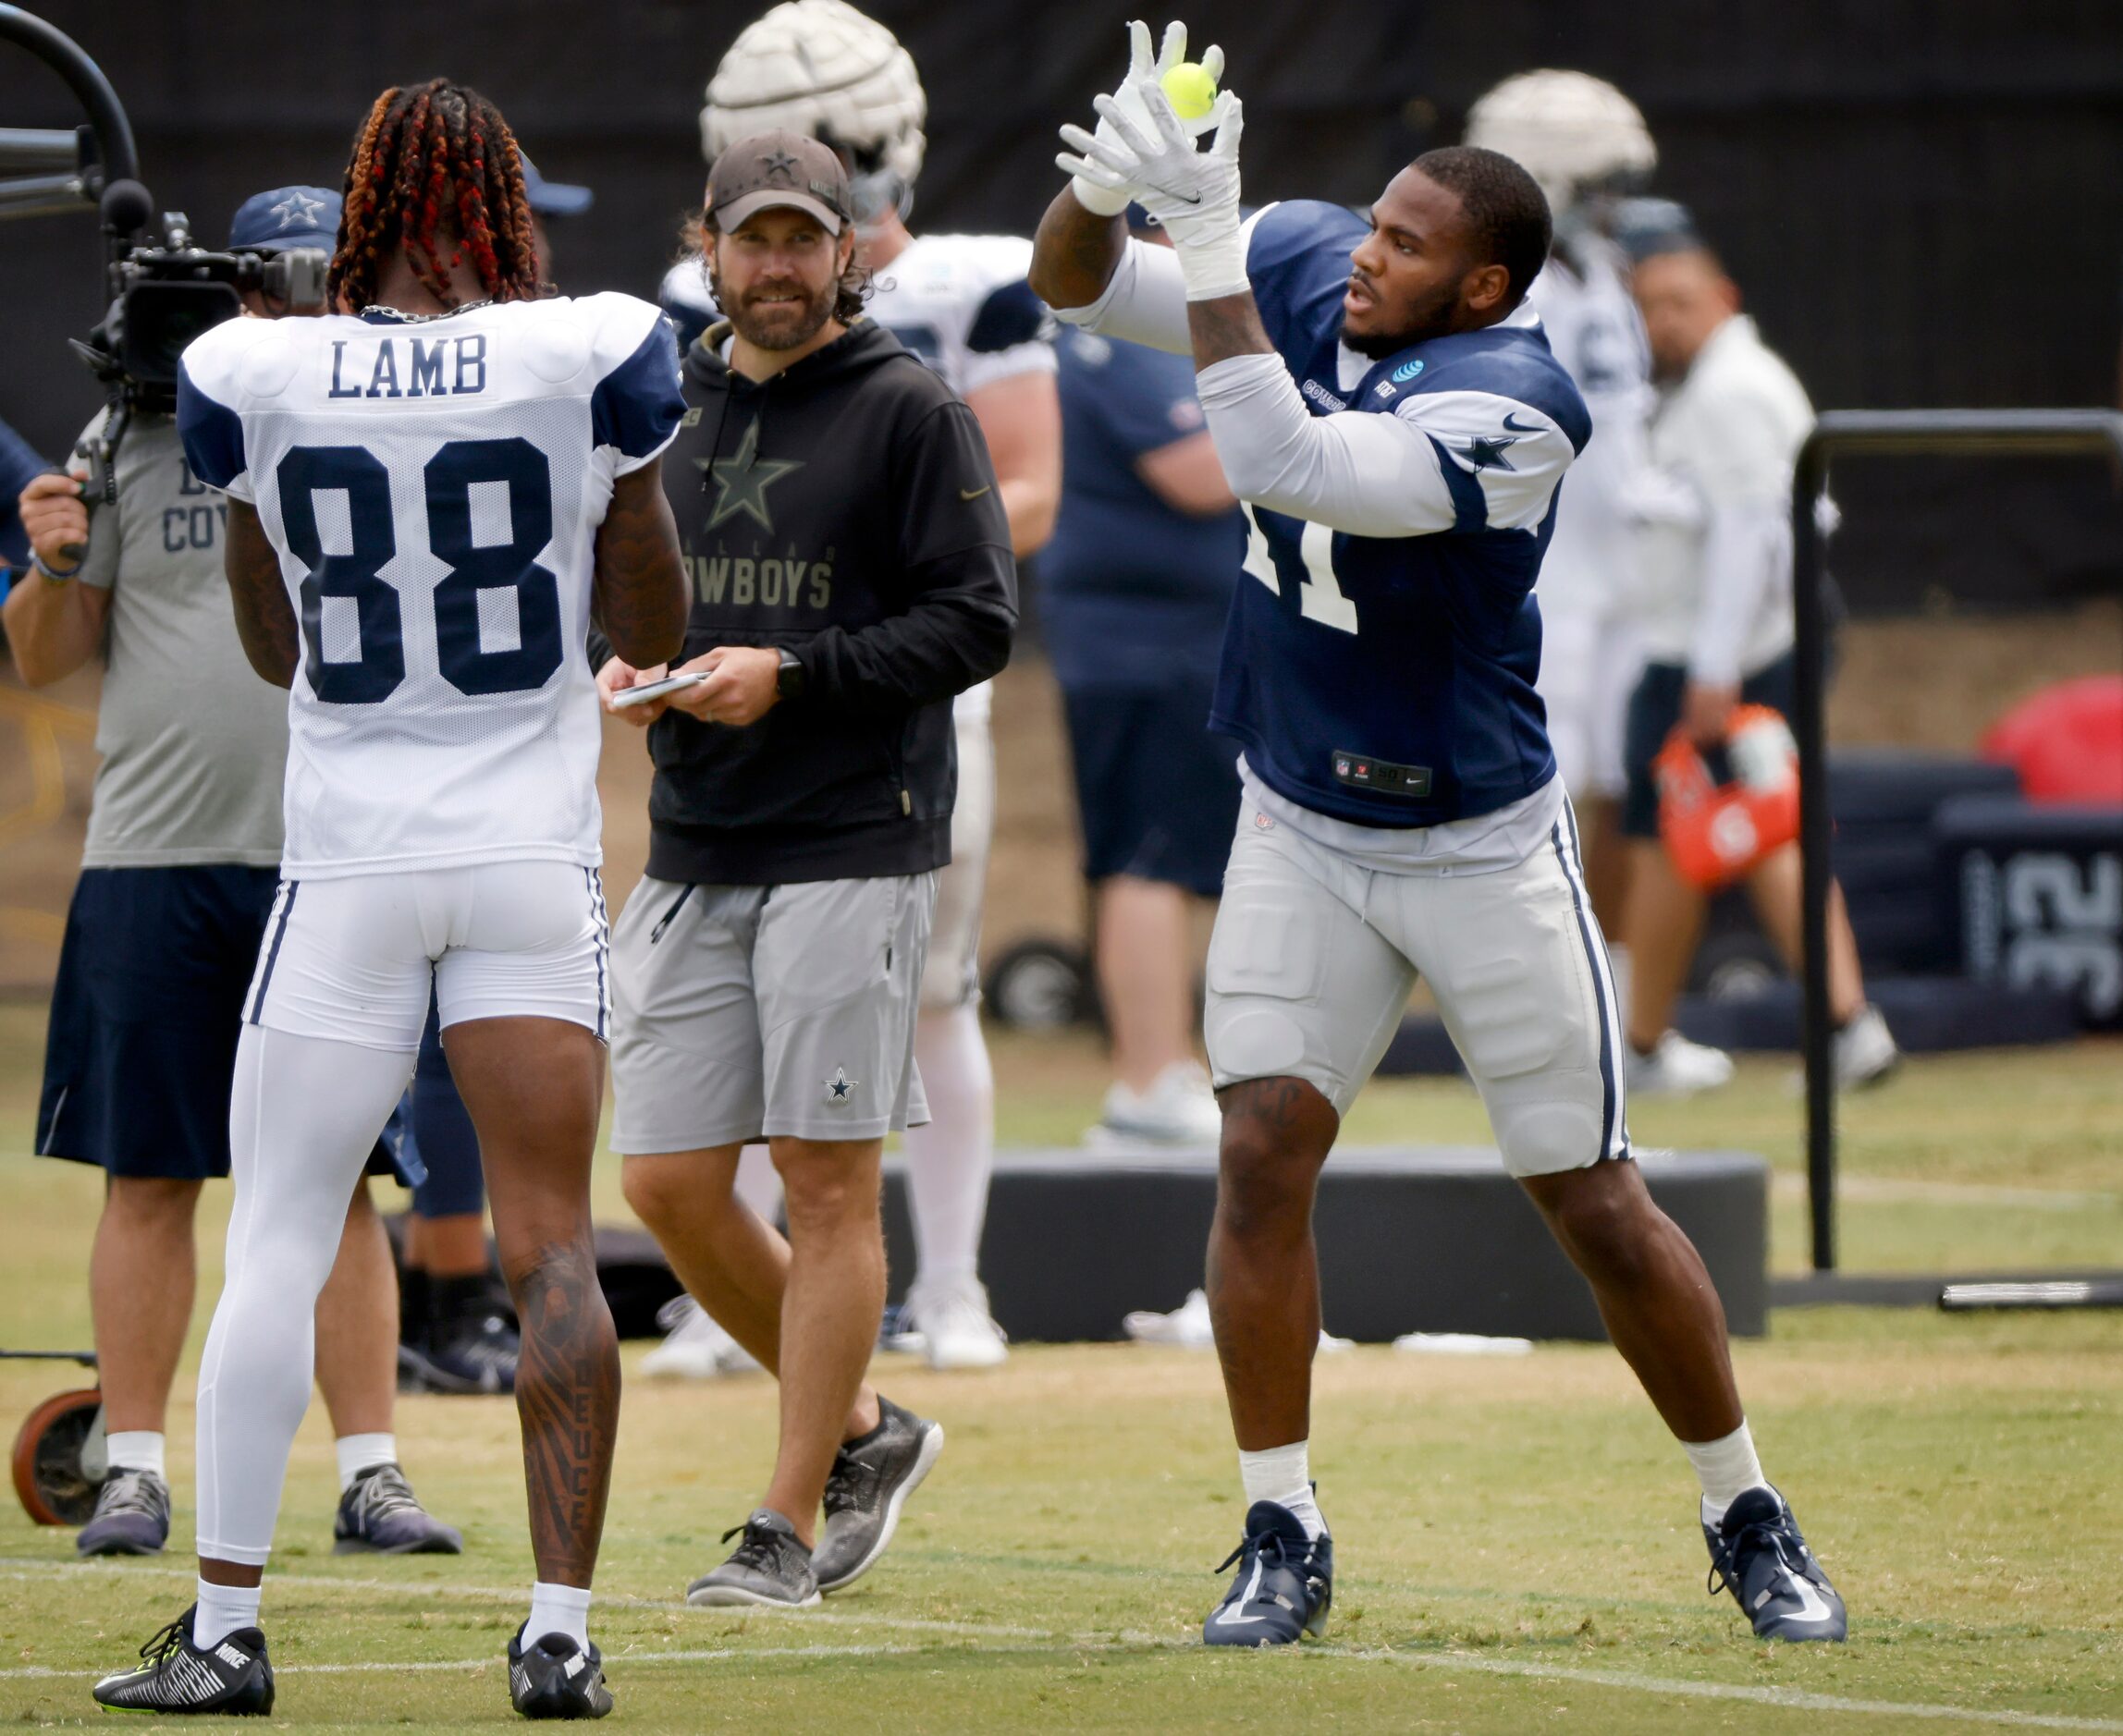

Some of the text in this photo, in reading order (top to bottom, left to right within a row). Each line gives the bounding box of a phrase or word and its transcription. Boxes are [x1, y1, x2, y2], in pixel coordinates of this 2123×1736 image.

[328, 334, 486, 398] LAMB
[276, 436, 564, 704] 88
[215, 1643, 251, 1669] NIKE
